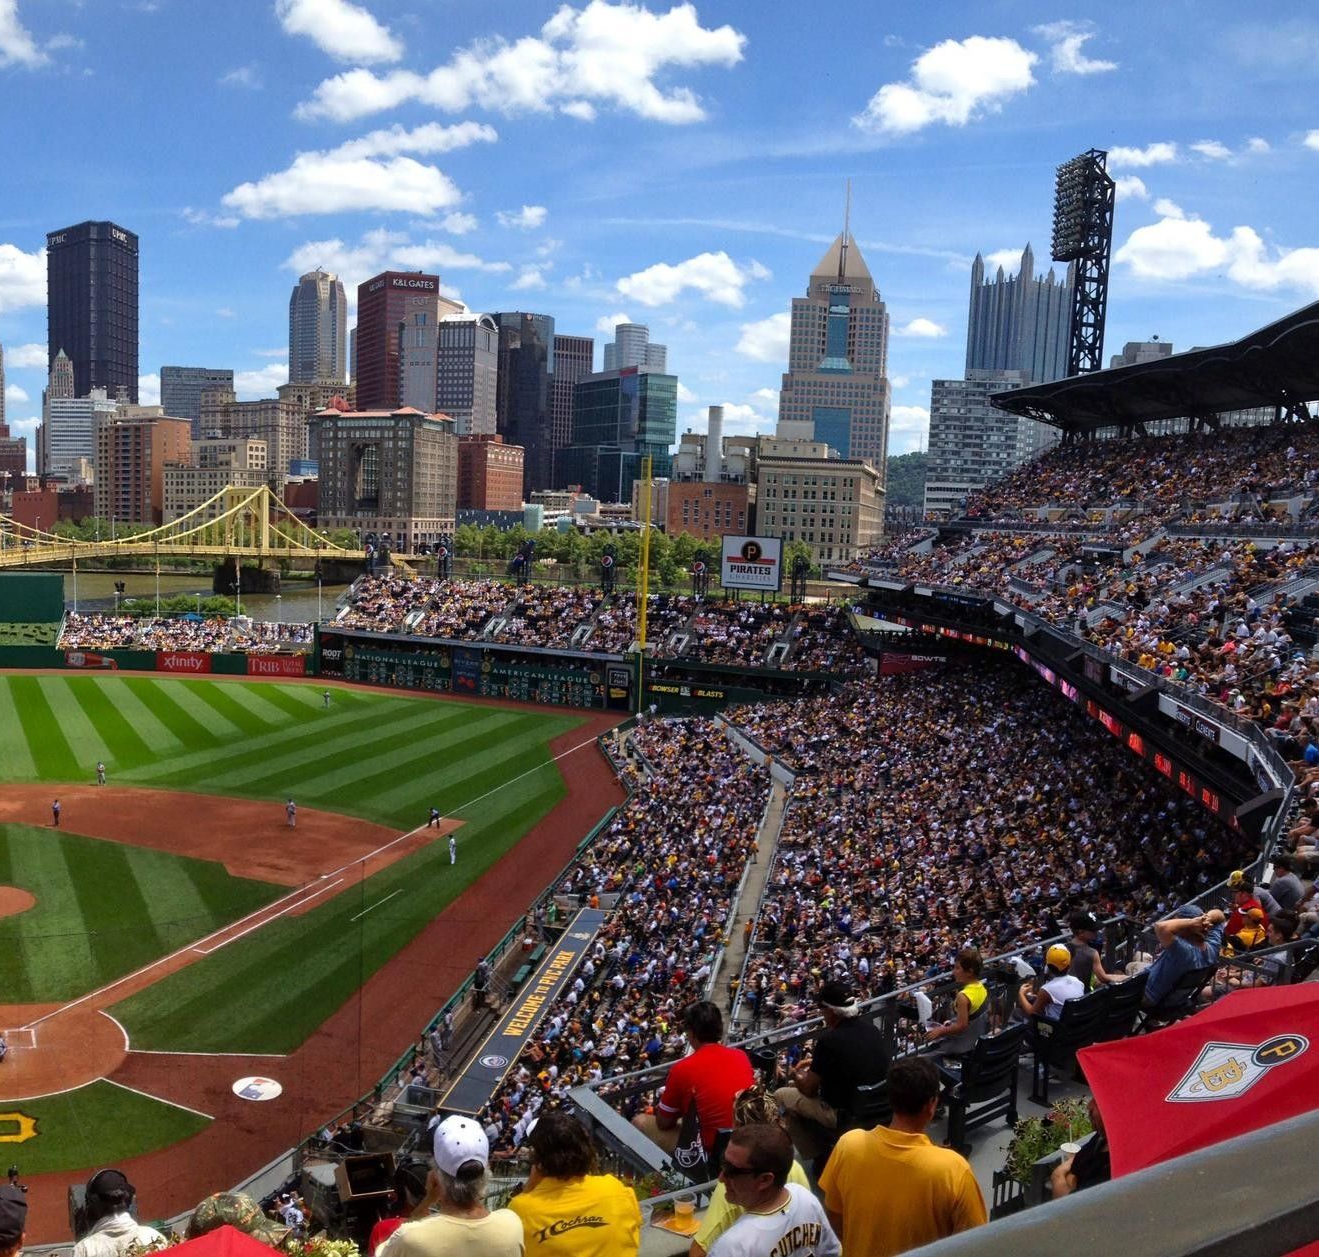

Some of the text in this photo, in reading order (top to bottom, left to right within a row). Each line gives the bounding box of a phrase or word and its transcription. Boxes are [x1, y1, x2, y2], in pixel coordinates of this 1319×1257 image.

[393, 278, 408, 287] K&L
[409, 280, 434, 289] GATES
[748, 546, 756, 558] P
[730, 564, 771, 575] PIRATES
[323, 649, 342, 657] ROOT
[911, 655, 947, 663] BOWTIE
[163, 655, 203, 670] xfinity
[250, 658, 279, 672] TRIB
[355, 654, 439, 668] NATIONAL LEAGUE
[492, 668, 588, 684] AMERICAN LEAGUE
[651, 685, 723, 698] BOWSER BLASTS
[502, 950, 576, 1036] WELCOME TO PNC PARK
[1259, 1041, 1297, 1057] P
[549, 1215, 603, 1236] Cochran
